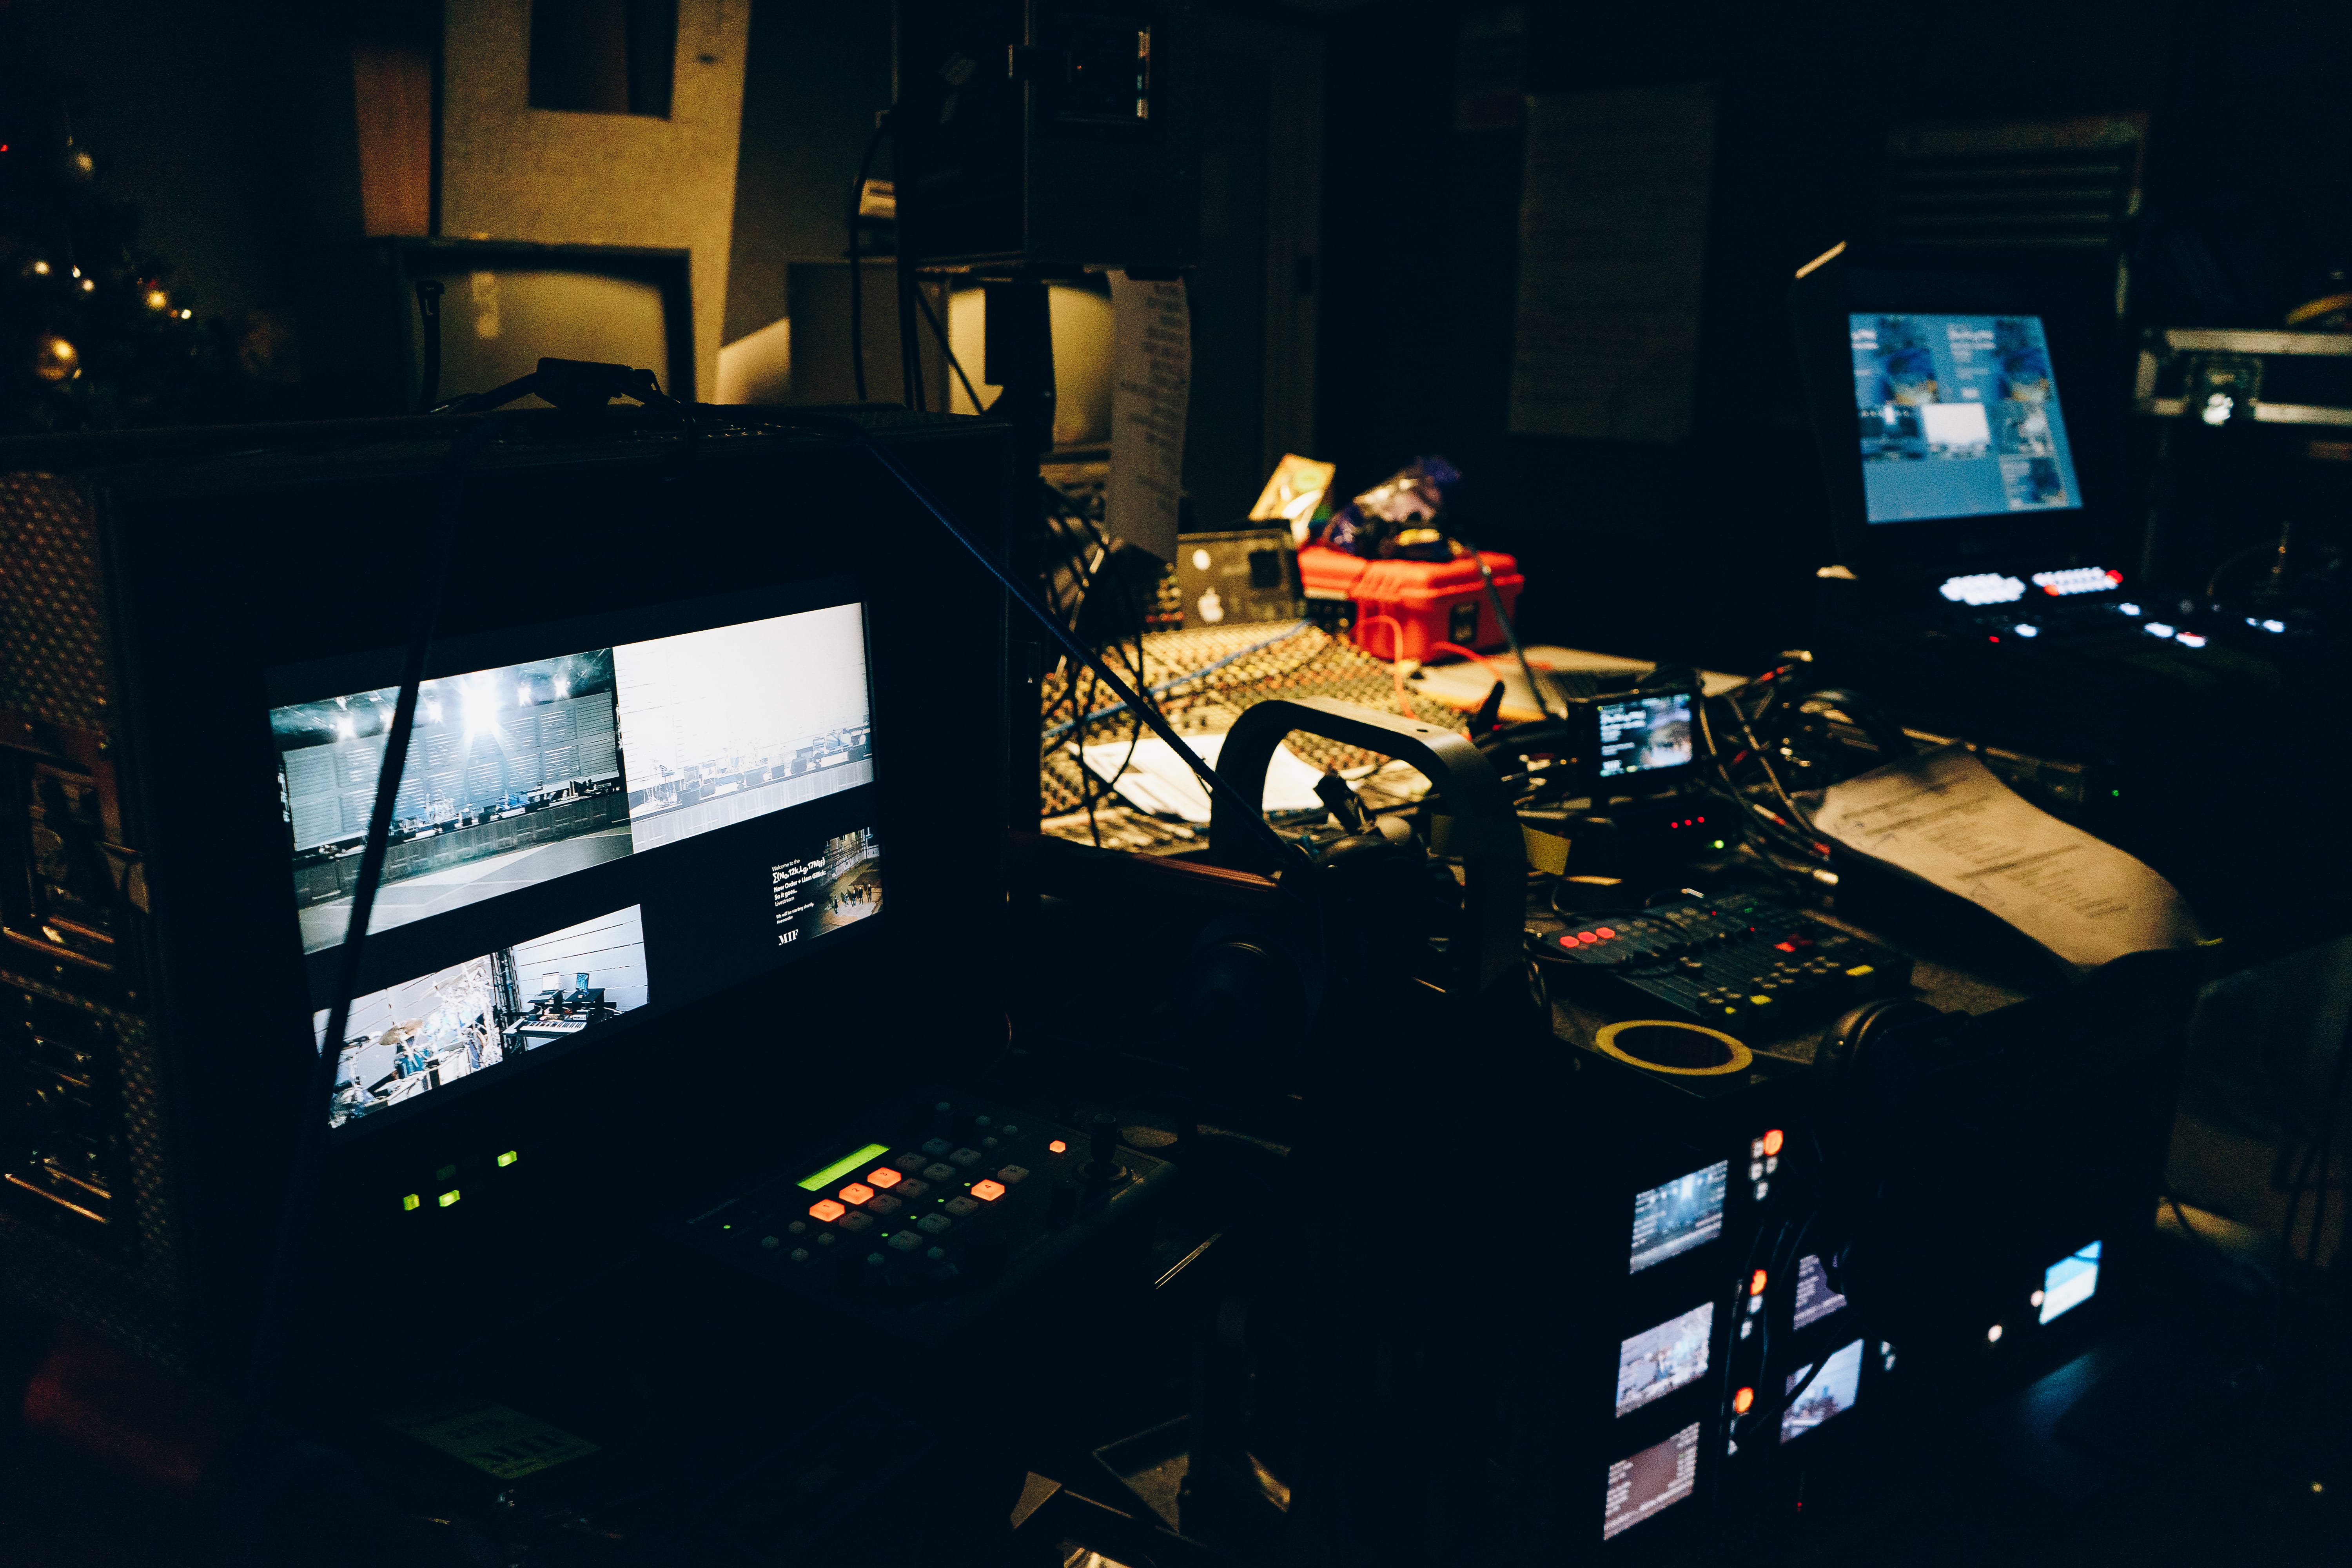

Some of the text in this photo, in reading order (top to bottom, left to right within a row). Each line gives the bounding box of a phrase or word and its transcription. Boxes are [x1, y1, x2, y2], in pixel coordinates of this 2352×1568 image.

[772, 863, 789, 871] Welcome
[784, 880, 798, 889] Order
[775, 897, 795, 907] Livestream
[778, 929, 799, 946] MIF
